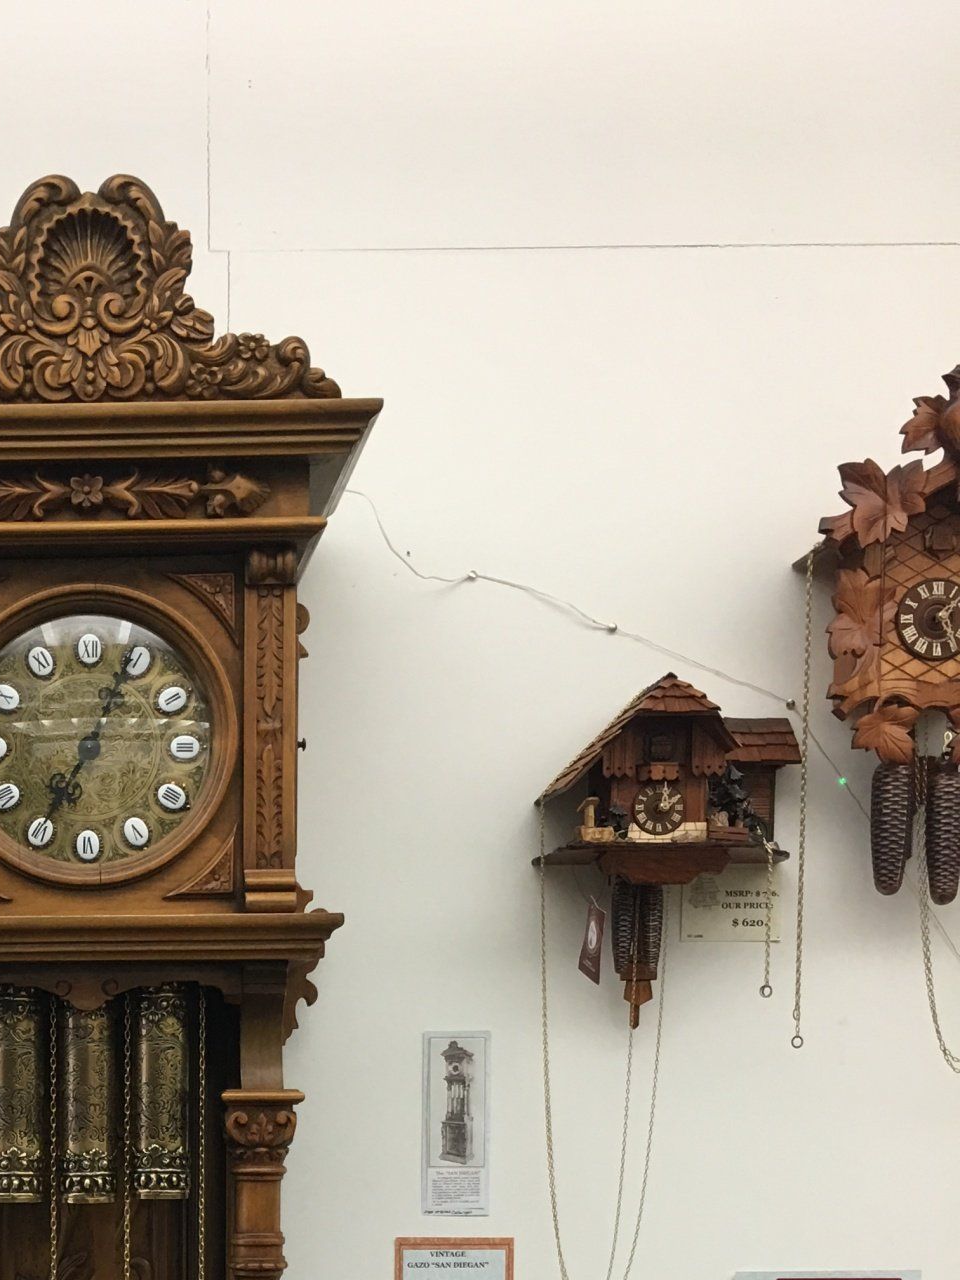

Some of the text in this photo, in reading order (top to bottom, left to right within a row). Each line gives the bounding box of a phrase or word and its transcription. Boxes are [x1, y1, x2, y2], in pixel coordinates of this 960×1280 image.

[83, 639, 98, 658] XII
[176, 742, 194, 752] III
[732, 918, 739, 927] $
